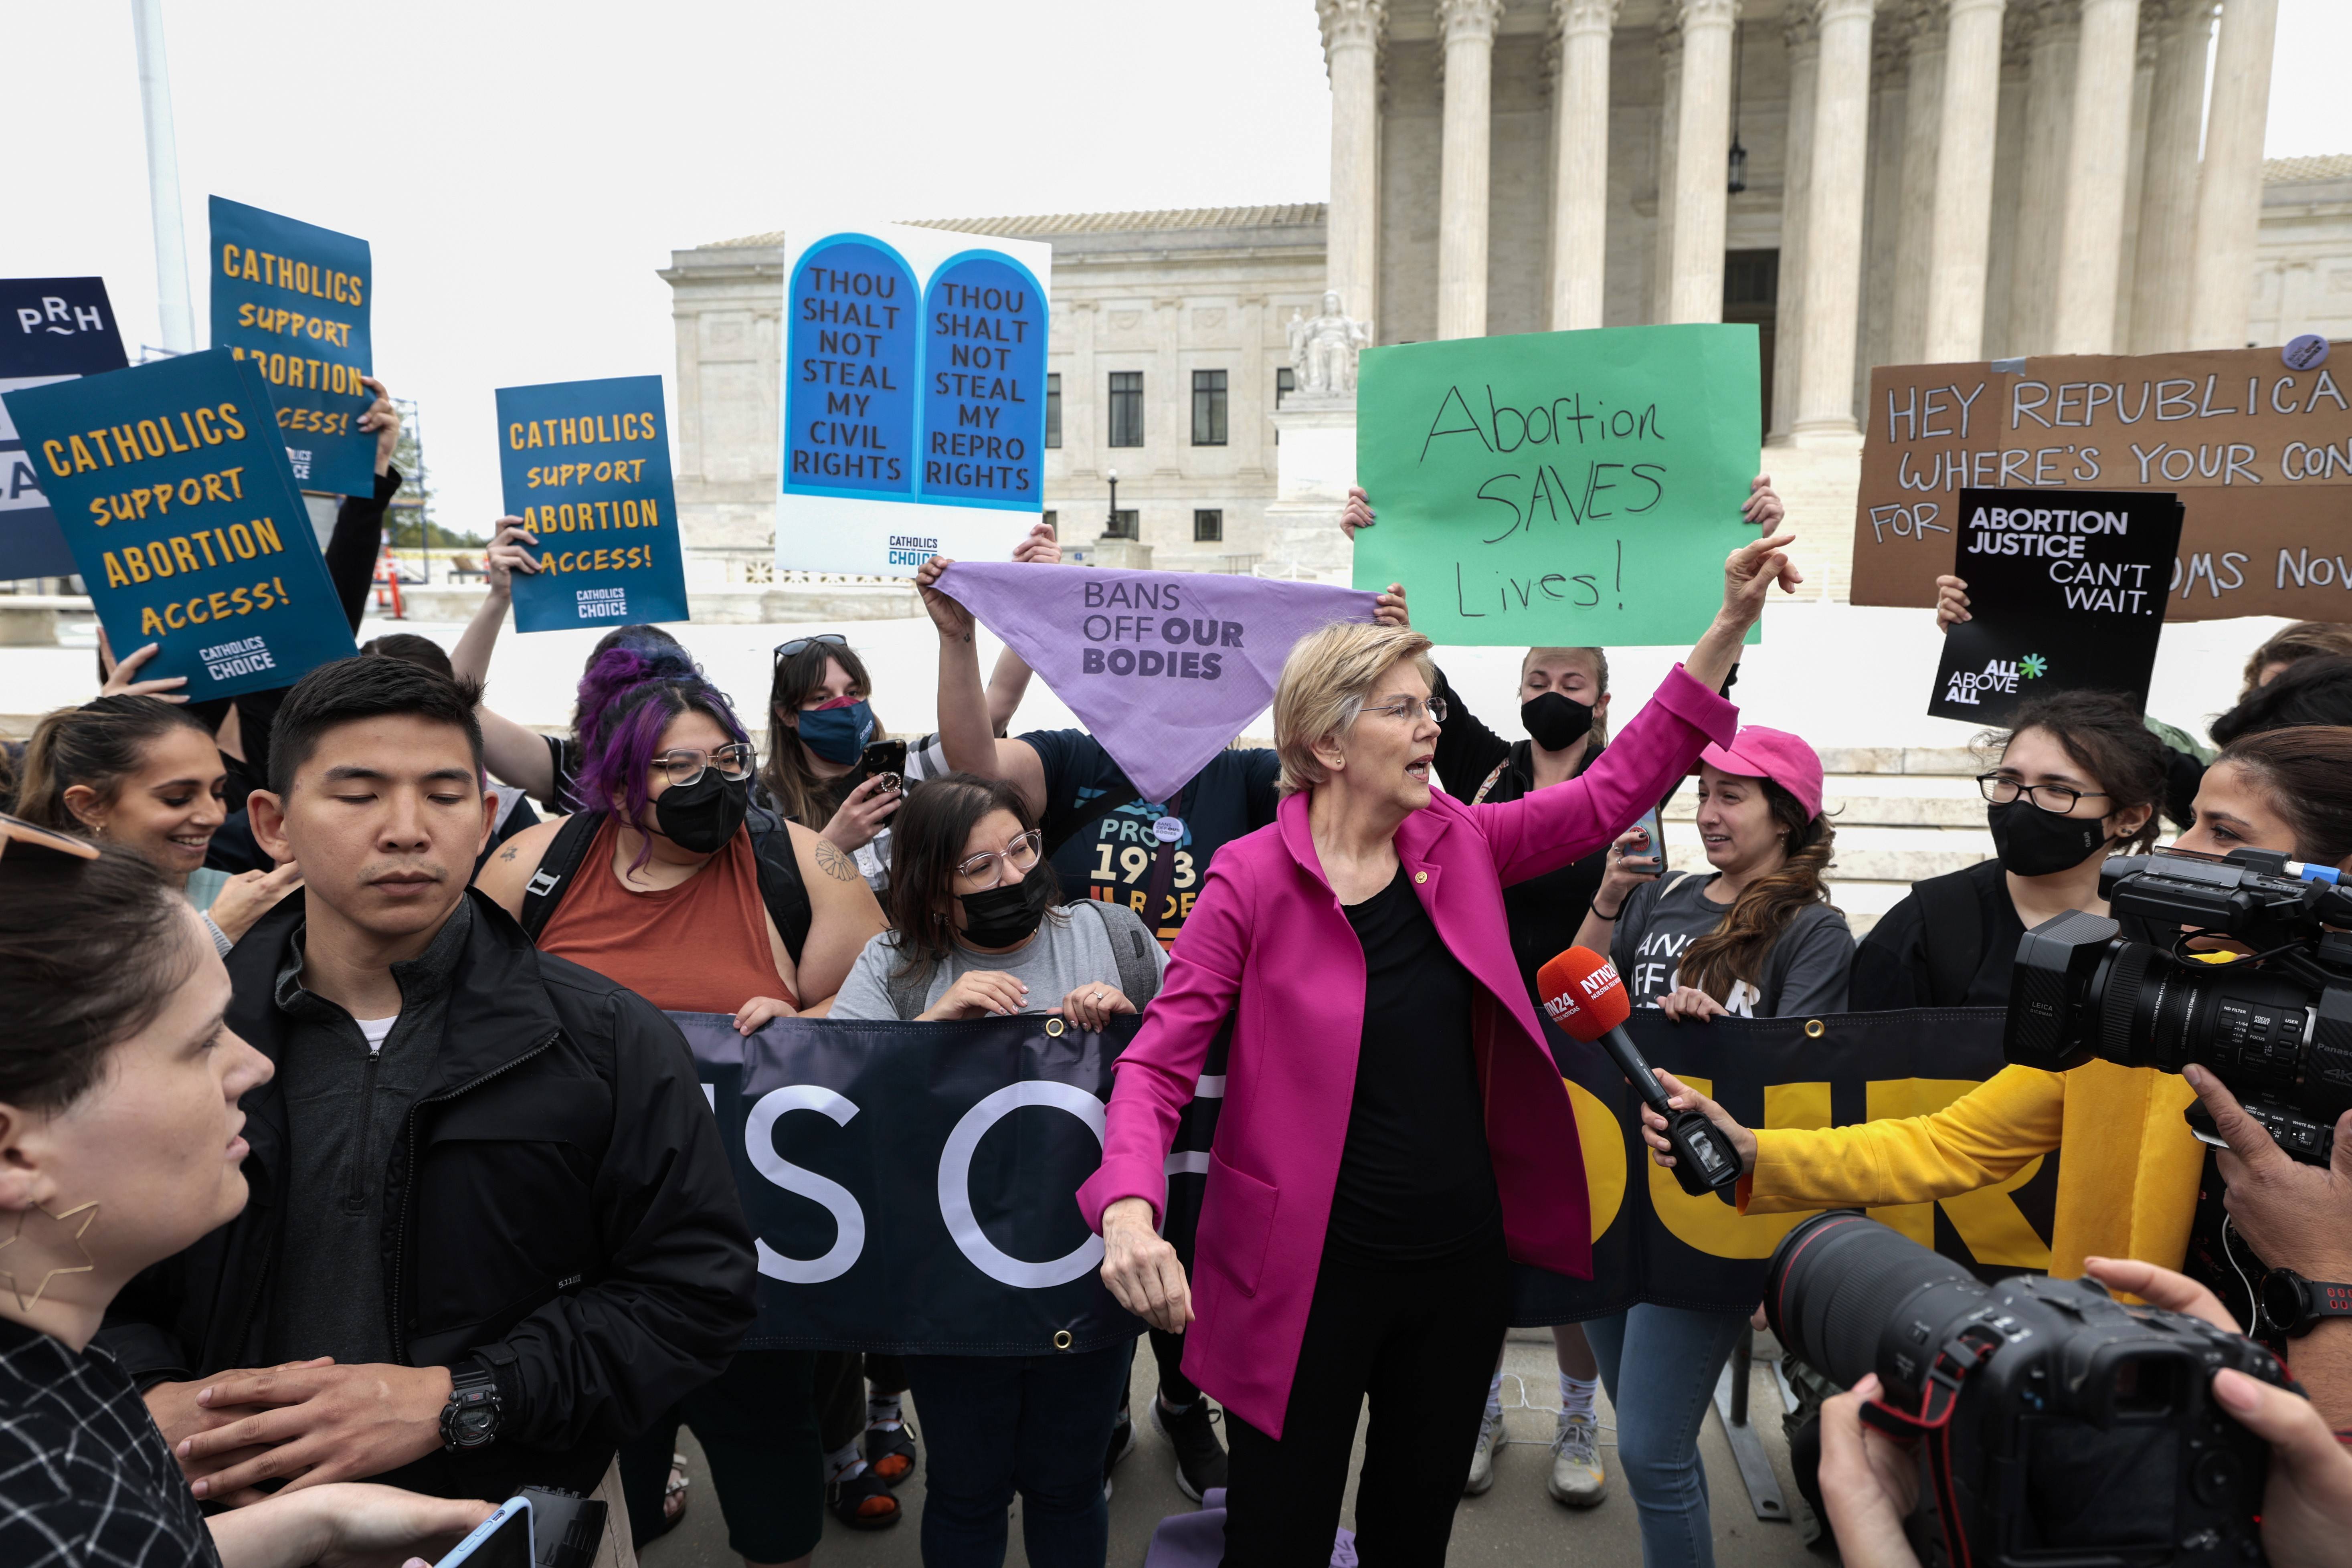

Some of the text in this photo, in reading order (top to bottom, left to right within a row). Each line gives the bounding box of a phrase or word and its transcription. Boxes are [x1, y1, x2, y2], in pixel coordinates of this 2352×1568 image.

[223, 244, 362, 306] CATHOLICS
[809, 267, 895, 299] THOU
[942, 283, 1024, 313] THOU
[16, 297, 104, 334] PRH
[238, 303, 352, 348] SUPPORT
[803, 298, 900, 329] SHALT
[935, 313, 1029, 343] SHALT
[819, 330, 882, 358] NOT
[952, 344, 1011, 371] NOT
[803, 359, 897, 390] STEAL
[935, 372, 1025, 402] STEAL
[827, 392, 871, 417] MY
[959, 404, 1000, 429] MY
[1888, 382, 1985, 443] HEY
[509, 412, 656, 450] CATHOLICS
[810, 421, 886, 449] CIVIL
[1419, 384, 1665, 463] Abortion
[43, 403, 247, 477] CATHOLICS
[932, 431, 1025, 461] REPRO
[527, 459, 646, 488] SUPPORT
[793, 450, 902, 481] RIGHTS
[926, 461, 1029, 491] RIGHTS
[1898, 445, 2101, 493] WHERE'S
[2130, 442, 2262, 485] YOUR
[89, 467, 244, 526] SUPPORT
[1476, 459, 1666, 544] SAVES
[523, 499, 658, 534] ABORTION
[1869, 502, 1952, 544] FOR
[1969, 507, 2128, 536] ABORTION
[103, 518, 284, 588] ABORTION
[890, 535, 938, 548] CATHOLICS
[1967, 532, 2086, 560] JUSTICE
[540, 545, 651, 576] ACCESS!
[889, 551, 937, 566] CHOIC
[1457, 538, 1623, 617] Lives!
[2049, 560, 2151, 588] CAN'T
[142, 578, 291, 636] ACCESS!
[576, 588, 624, 601] CATHOLICS
[1084, 582, 1181, 611] BANS
[2064, 586, 2153, 616] WAIT.
[578, 602, 627, 618] CHOICE
[1083, 614, 1244, 648] OFF OUR
[199, 636, 265, 661] CATHOLICS
[208, 652, 276, 680] CHOICE
[1082, 648, 1222, 681] BODIES
[1984, 659, 2020, 678] ALL
[1944, 687, 1980, 705] ALL
[1948, 671, 2018, 694] ABOVE
[1090, 843, 1196, 888] 193
[1591, 985, 1610, 1000] NUESTRA
[2032, 1001, 2053, 1011] LEICA
[2188, 988, 2198, 1007] STABILIZER
[1562, 1006, 1580, 1018] NOTICIAS
[2030, 1008, 2053, 1018] DICOMAR
[558, 1278, 573, 1289] 5.11
